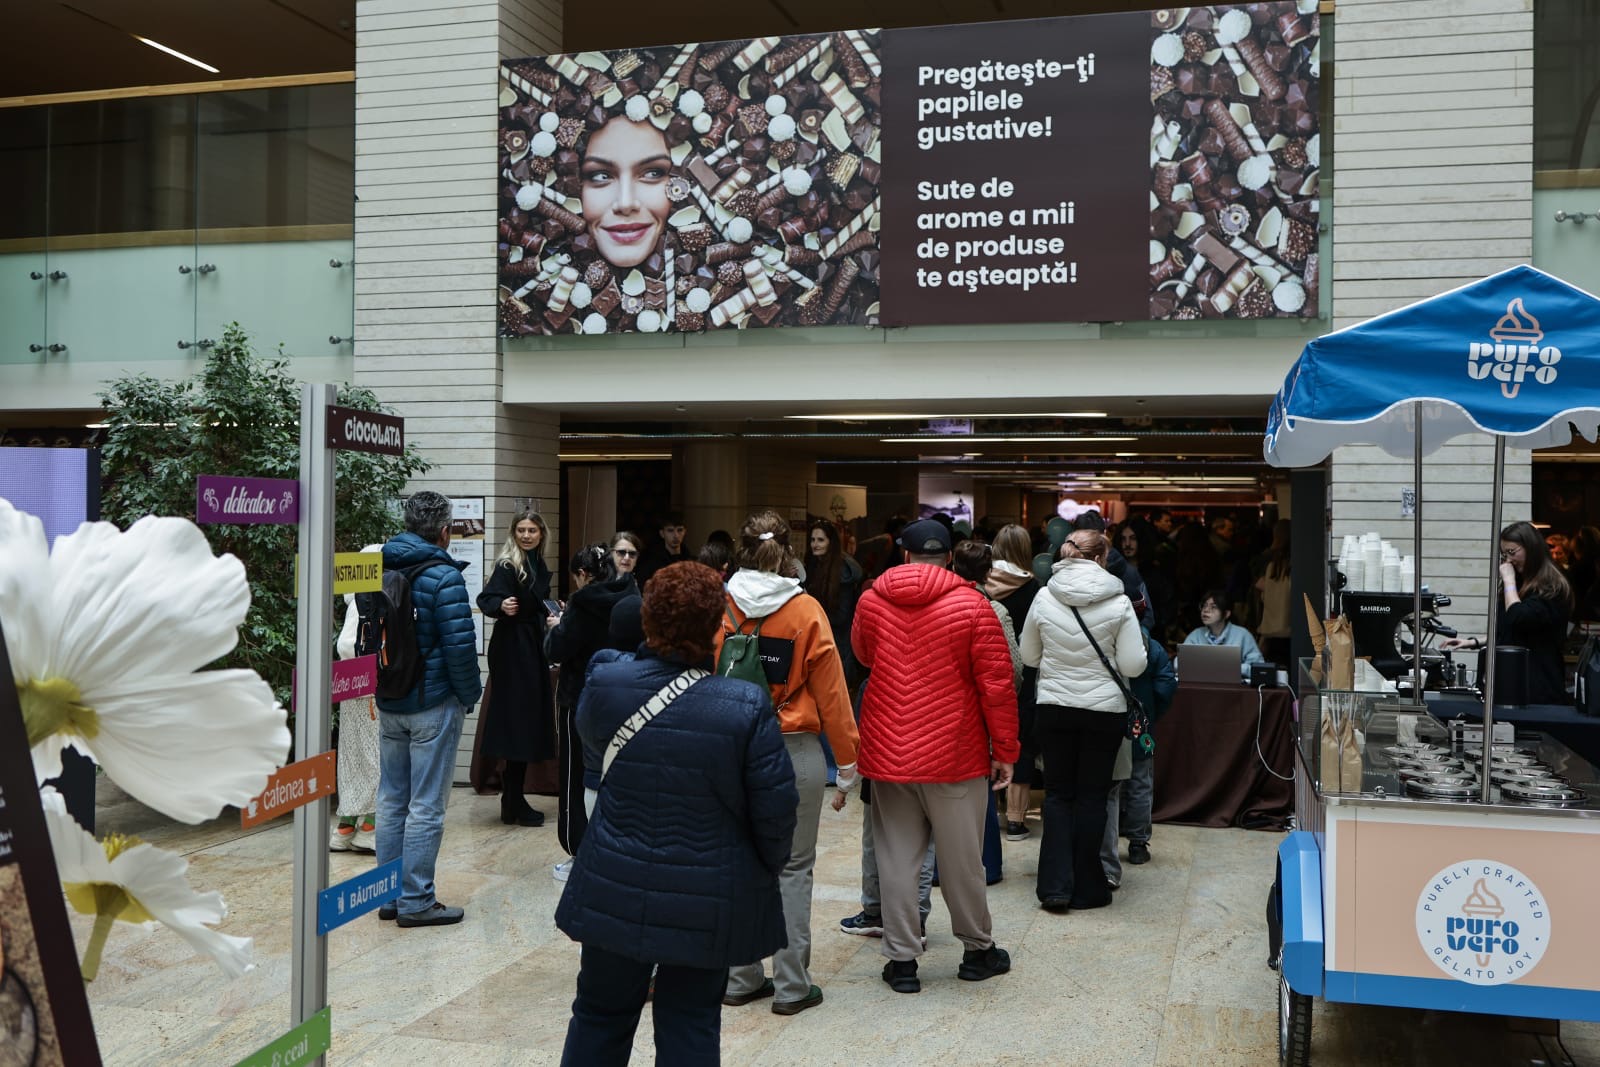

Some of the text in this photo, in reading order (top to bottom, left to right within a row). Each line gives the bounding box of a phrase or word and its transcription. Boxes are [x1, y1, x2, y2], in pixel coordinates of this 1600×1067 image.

[918, 89, 1024, 121] papilele
[917, 116, 1052, 150] gustative!
[917, 177, 1014, 201] Sute de
[917, 201, 1075, 229] arome a mii
[917, 234, 1064, 264] de produse
[917, 267, 942, 287] te
[1468, 342, 1562, 366] puro
[1468, 361, 1558, 385] vero
[223, 485, 277, 514] delicatese
[335, 563, 378, 582] NSTRATII LIVE
[767, 655, 780, 663] DAY
[351, 671, 370, 695] copii
[263, 778, 304, 811] cafenea
[1424, 866, 1543, 919] PURELY CRAFTED
[1446, 916, 1520, 938] puro
[1446, 934, 1520, 955] vero
[1433, 947, 1533, 979] GELATO JOY
[284, 1033, 309, 1066] ceai
